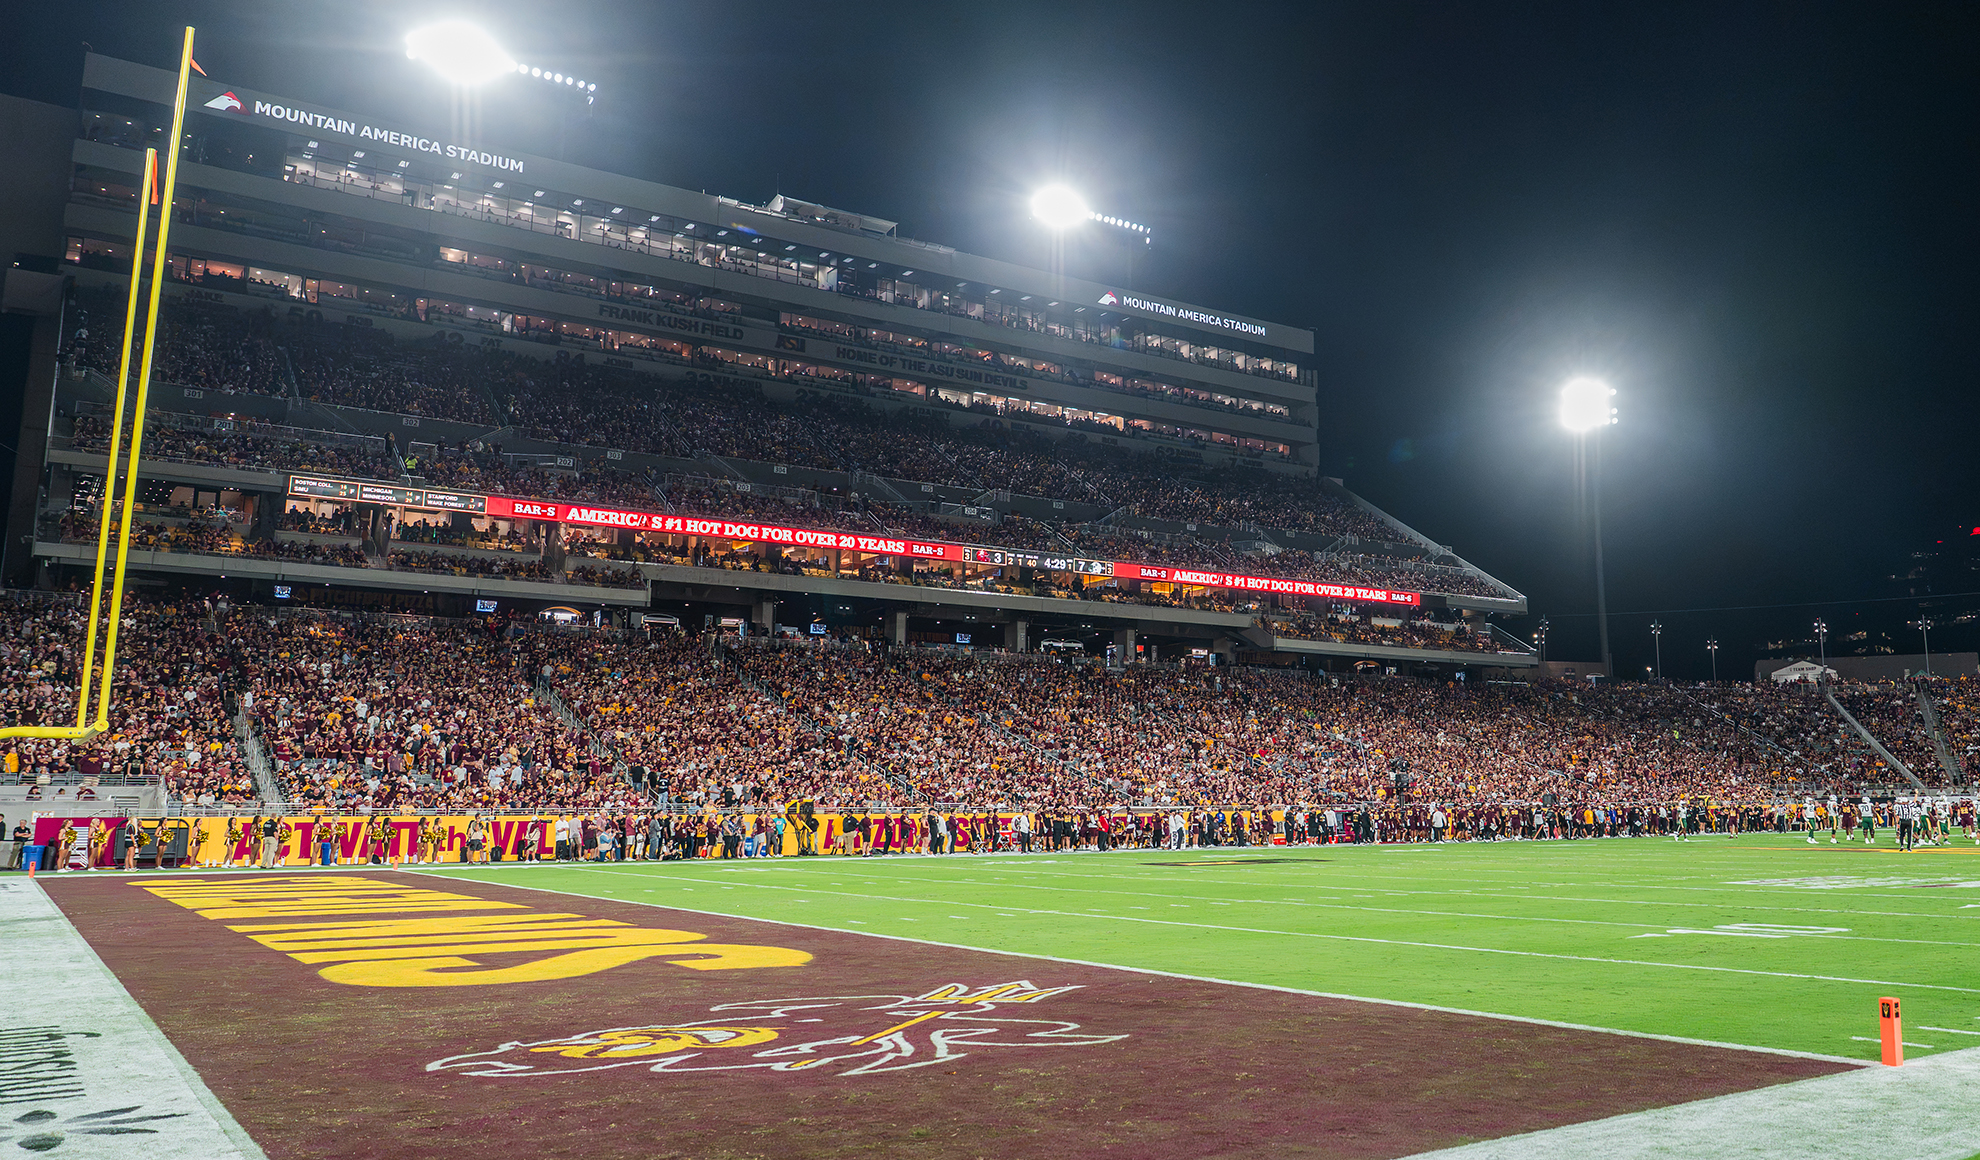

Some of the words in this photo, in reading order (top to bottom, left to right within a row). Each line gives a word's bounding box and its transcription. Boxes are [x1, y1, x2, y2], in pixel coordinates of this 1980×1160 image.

[254, 100, 355, 136] MOUNTAIN
[360, 125, 441, 156] AMERICA
[446, 145, 524, 174] STADIUM
[1123, 296, 1176, 317] MOUNTAIN
[1178, 308, 1222, 327] AMERICA
[1223, 318, 1266, 337] STADIUM
[599, 305, 654, 325] FRANK
[656, 313, 699, 333] KUSH
[701, 322, 744, 341] FIELD
[836, 346, 877, 364] HOME
[878, 354, 898, 368] OF
[899, 357, 927, 372] THE
[928, 363, 955, 378] ASU
[955, 367, 984, 383] SUN
[984, 372, 1028, 391] DEVILS
[186, 389, 202, 399] 301
[217, 421, 231, 430] 201
[404, 417, 419, 427] 302
[558, 457, 572, 466] 202
[362, 486, 393, 495] MICHIGAN
[362, 493, 397, 502] MINNESOTA
[427, 493, 458, 502] STANFORD
[514, 503, 556, 517] BAR-S
[665, 517, 683, 531] #1
[685, 520, 721, 535] HOT
[724, 523, 758, 538] DOG
[761, 527, 793, 541] FOR
[795, 530, 837, 546] OVER
[838, 535, 856, 548] 20
[857, 536, 905, 554] YEARS
[912, 543, 944, 556] BAR-S
[964, 552, 970, 560] 3
[994, 552, 1002, 564] 3
[1007, 557, 1014, 565] 2
[1026, 559, 1037, 567] 40
[1044, 557, 1067, 570] 4:29
[1078, 561, 1086, 572] 7
[1140, 568, 1167, 578] BAR-S
[1234, 576, 1246, 587] #1
[1247, 577, 1270, 590] HOT
[1270, 580, 1294, 592] DOG
[1294, 582, 1315, 594] FOR
[1316, 584, 1344, 597] OVER
[1344, 587, 1355, 598] 20
[1355, 588, 1387, 601] YEARS
[1861, 804, 1870, 813] 70
[233, 821, 429, 861] ACTVATE
[224, 912, 814, 988] SUN
